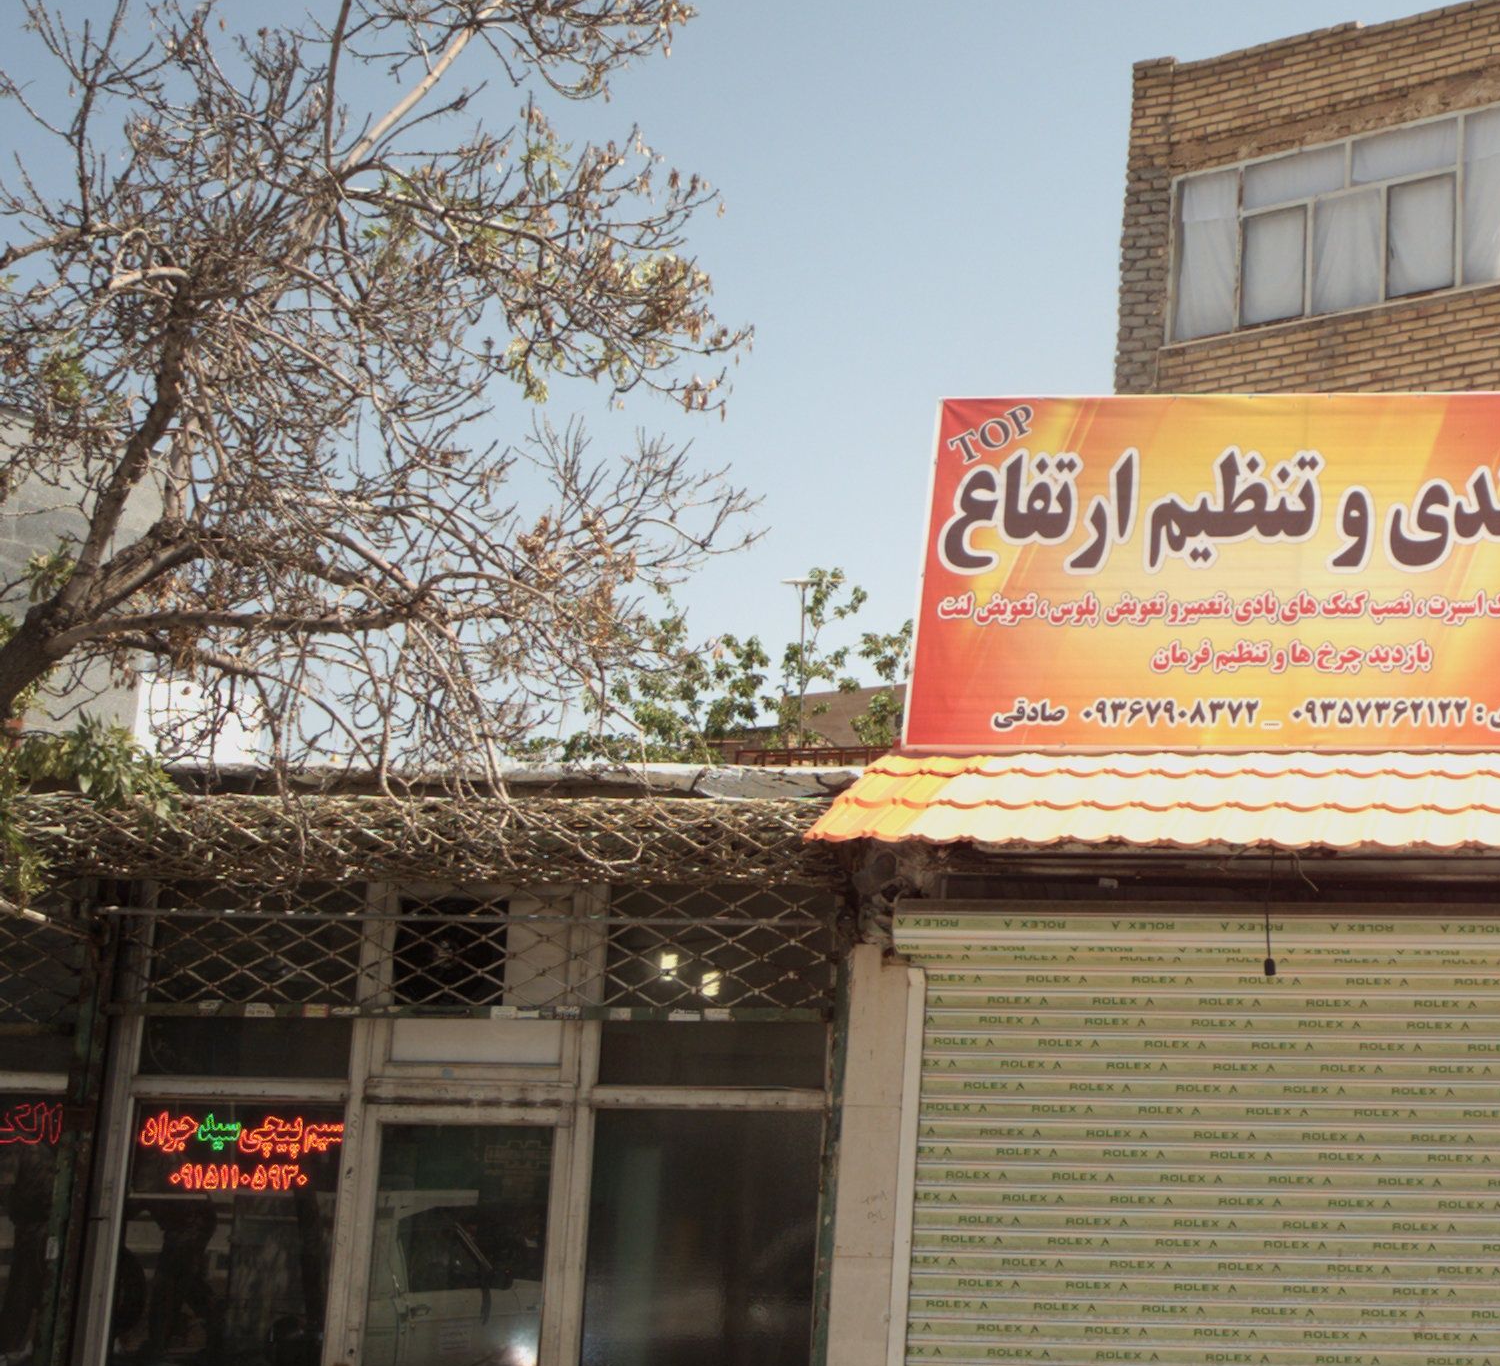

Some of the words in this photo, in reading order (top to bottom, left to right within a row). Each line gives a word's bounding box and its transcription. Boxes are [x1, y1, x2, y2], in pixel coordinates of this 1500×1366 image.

[949, 405, 1033, 463] TOP
[944, 447, 1136, 571] ارتفاع
[1148, 448, 1320, 571] تنظیم
[1333, 486, 1371, 568] و
[938, 594, 973, 620] لنت
[976, 595, 1036, 626] تعویض
[1050, 596, 1098, 627] پلوس
[1106, 593, 1166, 625] تعویض
[1234, 592, 1276, 624] بادی
[1281, 592, 1316, 622] های
[1321, 590, 1367, 618] کمک
[1369, 593, 1412, 623] نصب
[1427, 590, 1485, 624] اسپرت
[1151, 640, 1211, 673] فرمان
[1214, 641, 1268, 672] تنظیم
[1272, 650, 1285, 673] و
[1289, 641, 1311, 666] ها
[1315, 645, 1362, 673] چرخ
[1368, 640, 1432, 673] بازدید
[992, 699, 1067, 731] صادقی
[1081, 698, 1260, 725] ۰۹۳۶۷۹۰۸۳۷۲
[1291, 698, 1469, 726] ۰۹۳۵۷۳۶۲۱۲۲
[1026, 974, 1072, 984] ROLEX
[1453, 977, 1500, 987] ROLEX
[986, 995, 1032, 1005] ROLEX
[1198, 997, 1244, 1007] ROLEX
[1412, 999, 1460, 1009] ROLEX
[978, 1015, 1024, 1025] ROLEX
[1298, 1019, 1344, 1029] ROLEX
[1406, 1020, 1454, 1030] ROLEX
[1038, 1038, 1084, 1048] ROLEX
[1142, 1039, 1190, 1049] ROLEX
[1251, 1041, 1298, 1051] ROLEX
[999, 1059, 1046, 1069] ROLEX
[1319, 1063, 1367, 1073] ROLEX
[1427, 1064, 1475, 1073] ROLEX
[1176, 1083, 1222, 1093] ROLEX
[1392, 1086, 1438, 1096] ROLEX
[1032, 1104, 1078, 1114] ROLEX
[1136, 1105, 1184, 1115] ROLEX
[140, 1110, 199, 1153] جواد
[197, 1112, 241, 1151] سید
[238, 1114, 305, 1160] پیچی
[303, 1120, 345, 1154] سیم
[979, 1127, 1026, 1137] ROLEX
[1193, 1130, 1241, 1140] ROLEX
[1300, 1131, 1348, 1141] ROLEX
[1409, 1133, 1457, 1143] ROLEX
[995, 1147, 1042, 1157] ROLEX
[1103, 1148, 1149, 1158] ROLEX
[1318, 1152, 1366, 1162] ROLEX
[1426, 1153, 1474, 1163] ROLEX
[168, 1162, 309, 1191] ۰۹۱۵۱۱۰۵۹۳۰
[946, 1170, 992, 1180] ROLEX
[1158, 1173, 1206, 1183] ROLEX
[1267, 1175, 1315, 1185] ROLEX
[1377, 1177, 1425, 1187] ROLEX
[1000, 1193, 1048, 1203] ROLEX
[1108, 1195, 1156, 1205] ROLEX
[1438, 1200, 1486, 1210] ROLEX
[1064, 1216, 1112, 1225] ROLEX
[1282, 1220, 1330, 1230] ROLEX
[1392, 1222, 1440, 1232] ROLEX
[1048, 1236, 1094, 1246] ROLEX
[1263, 1239, 1311, 1249] ROLEX
[1371, 1241, 1419, 1251] ROLEX
[1002, 1257, 1048, 1267] ROLEX
[1109, 1259, 1157, 1269] ROLEX
[1327, 1263, 1375, 1273] ROLEX
[1436, 1265, 1484, 1275] ROLEX
[1065, 1280, 1113, 1290] ROLEX
[1173, 1282, 1221, 1292] ROLEX
[1391, 1287, 1439, 1297] ROLEX
[925, 1299, 972, 1309] ROLEX
[1251, 1306, 1299, 1316] ROLEX
[1361, 1308, 1409, 1318] ROLEX
[975, 1323, 1023, 1333] ROLEX
[1084, 1325, 1132, 1335] ROLEX
[1303, 1330, 1351, 1340] ROLEX
[1094, 1350, 1142, 1359] ROLEX
[1315, 1355, 1363, 1365] ROLEX
[1426, 1357, 1474, 1366] ROLEX
